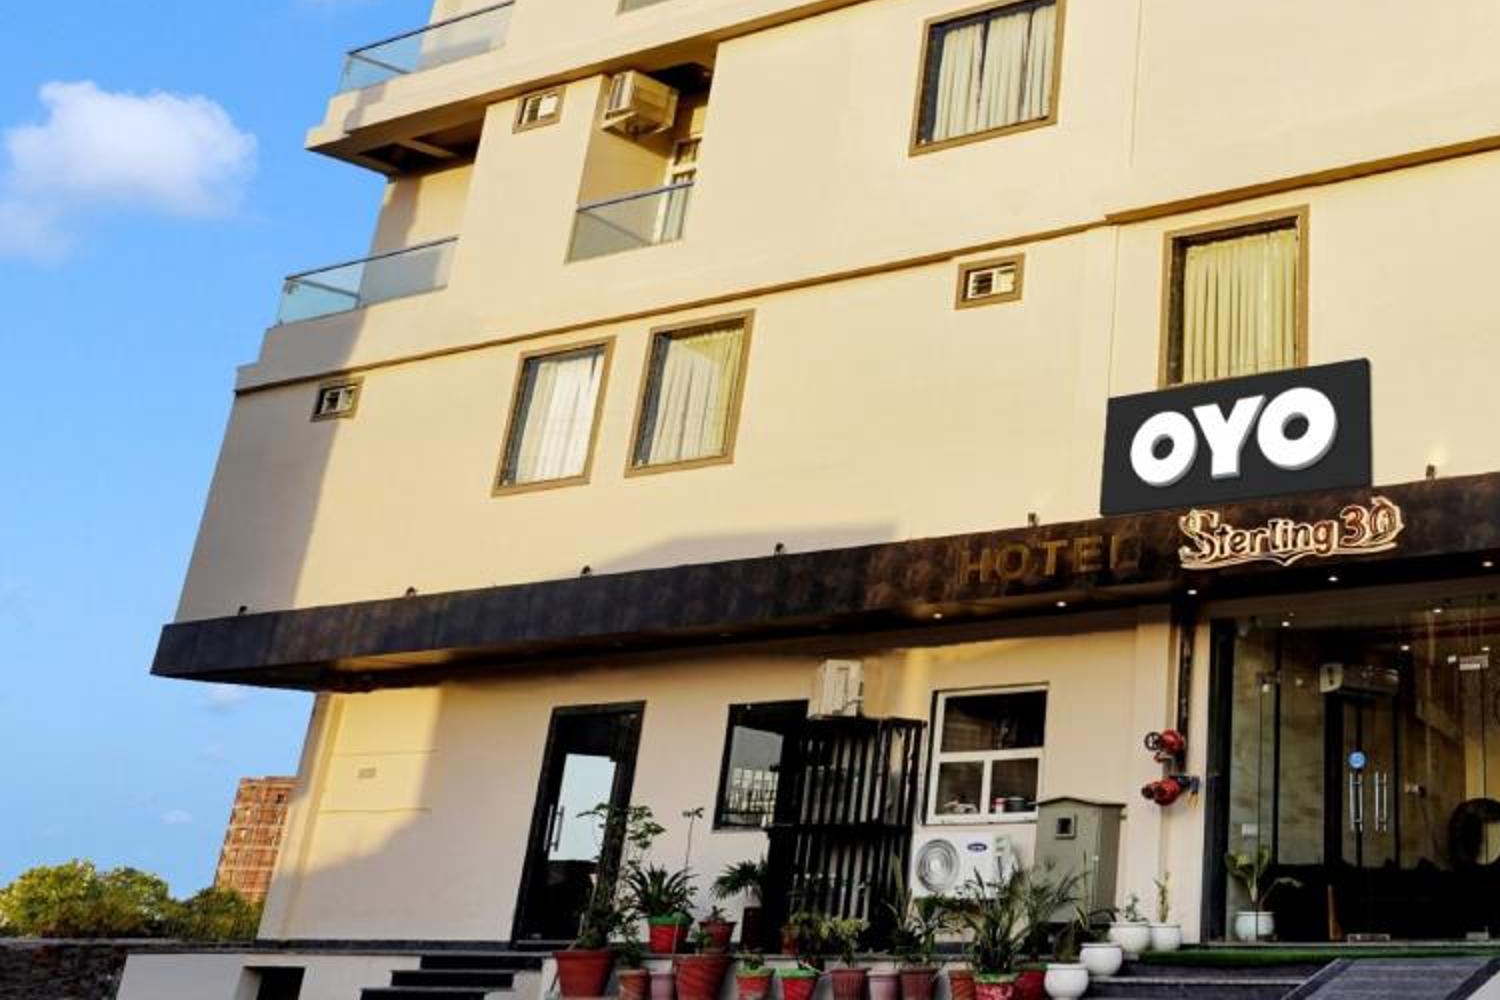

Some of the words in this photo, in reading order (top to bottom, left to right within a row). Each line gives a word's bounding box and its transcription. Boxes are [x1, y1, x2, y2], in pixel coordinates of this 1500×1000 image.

[1130, 386, 1338, 487] OYO
[958, 536, 1140, 584] HOTEL
[1178, 508, 1339, 565] Sterling
[1339, 496, 1405, 548] 30
